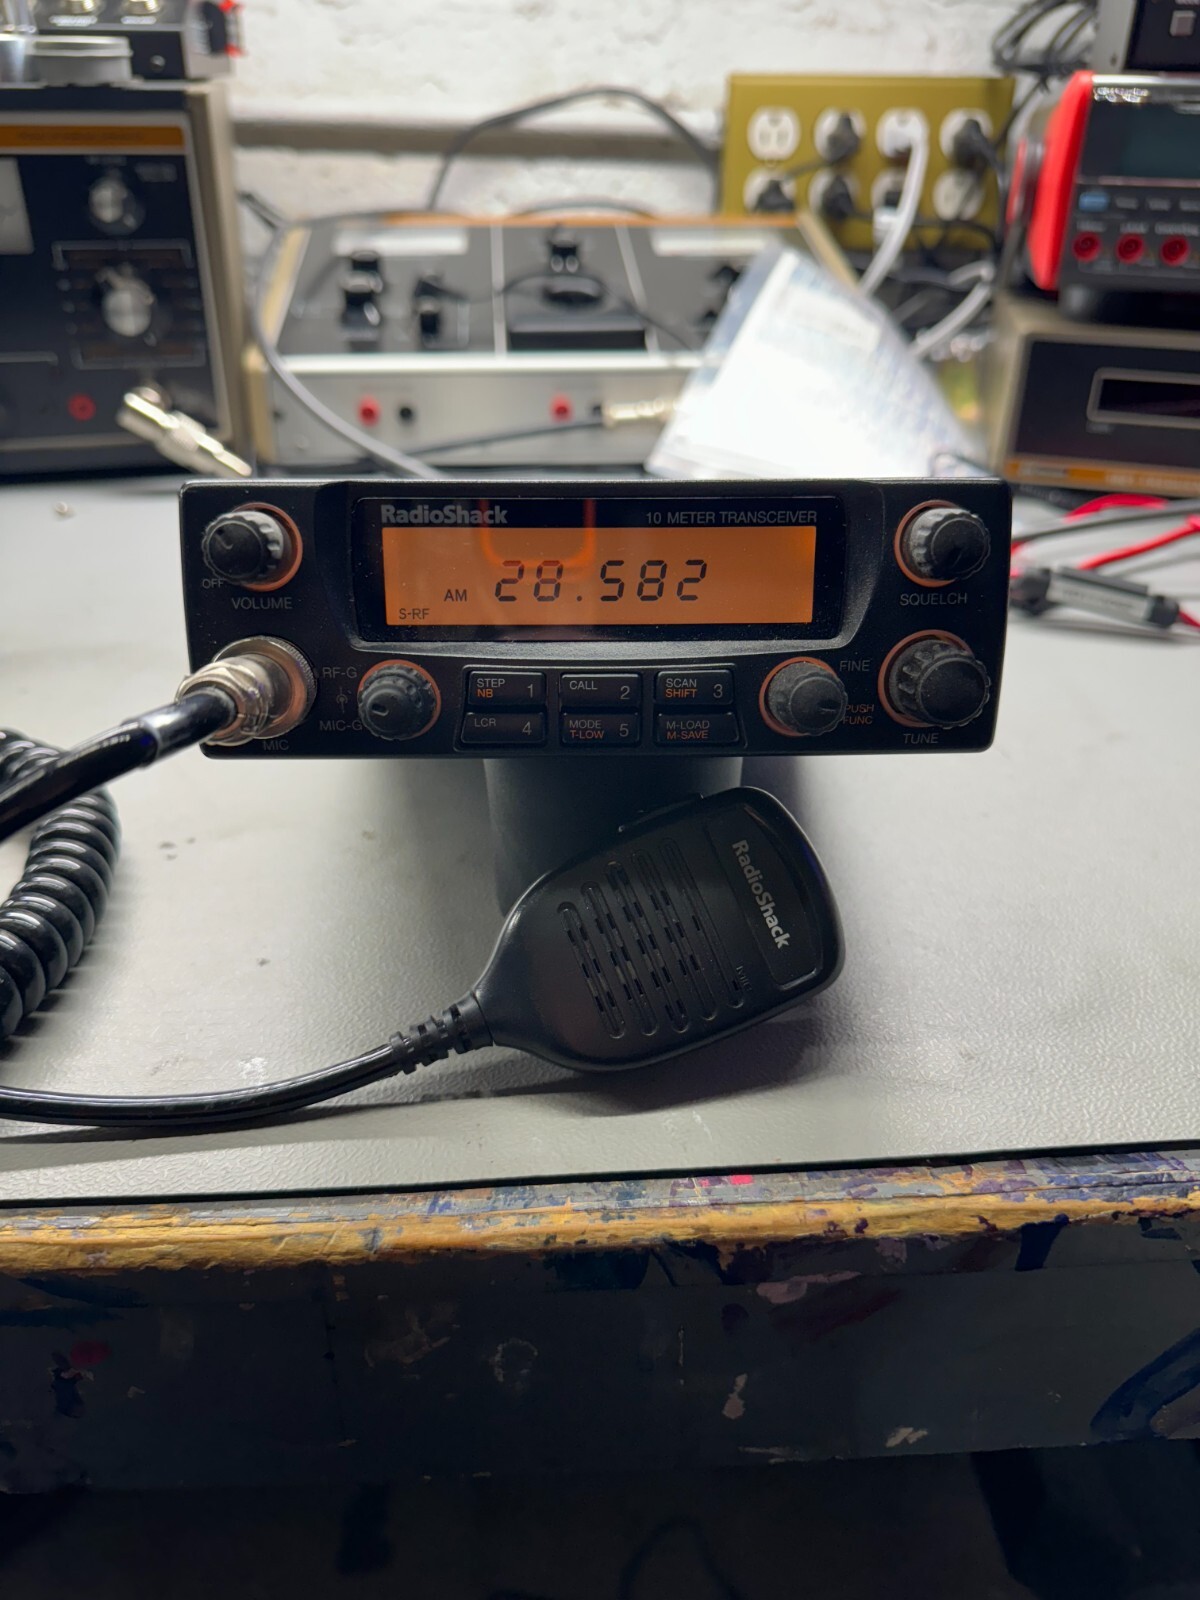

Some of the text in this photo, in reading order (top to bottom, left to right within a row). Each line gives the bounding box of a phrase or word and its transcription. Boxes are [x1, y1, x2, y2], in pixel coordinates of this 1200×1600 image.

[381, 504, 508, 525] RadioShack
[645, 510, 818, 525] 10 METER TRANSCEIVER
[494, 559, 708, 603] 28.582
[444, 588, 468, 602] AM
[900, 592, 968, 606] SQUELCH
[231, 596, 293, 610] VOLUME
[398, 607, 430, 620] S-RF
[839, 659, 871, 672] FINE
[322, 666, 358, 679] RF-G
[476, 678, 506, 689] STEP
[569, 680, 598, 690] CALL
[665, 678, 697, 689] SCAN
[476, 689, 494, 698] NB
[527, 684, 534, 698] 1
[620, 685, 631, 700] 2
[665, 688, 698, 698] SHIFT
[713, 684, 723, 698] 3
[845, 703, 875, 713] PUSH
[319, 719, 363, 732] MIC-G
[474, 717, 497, 728] LCR
[569, 719, 602, 730] MODE
[666, 720, 711, 730] M-LOAD
[843, 715, 873, 725] FUNC
[522, 721, 532, 735] 4
[569, 729, 605, 739] T-LOW
[619, 723, 629, 738] 5
[666, 729, 709, 740] M-SAVE
[263, 739, 290, 751] MIC
[903, 733, 939, 745] TUNE
[732, 839, 791, 950] RadioShack
